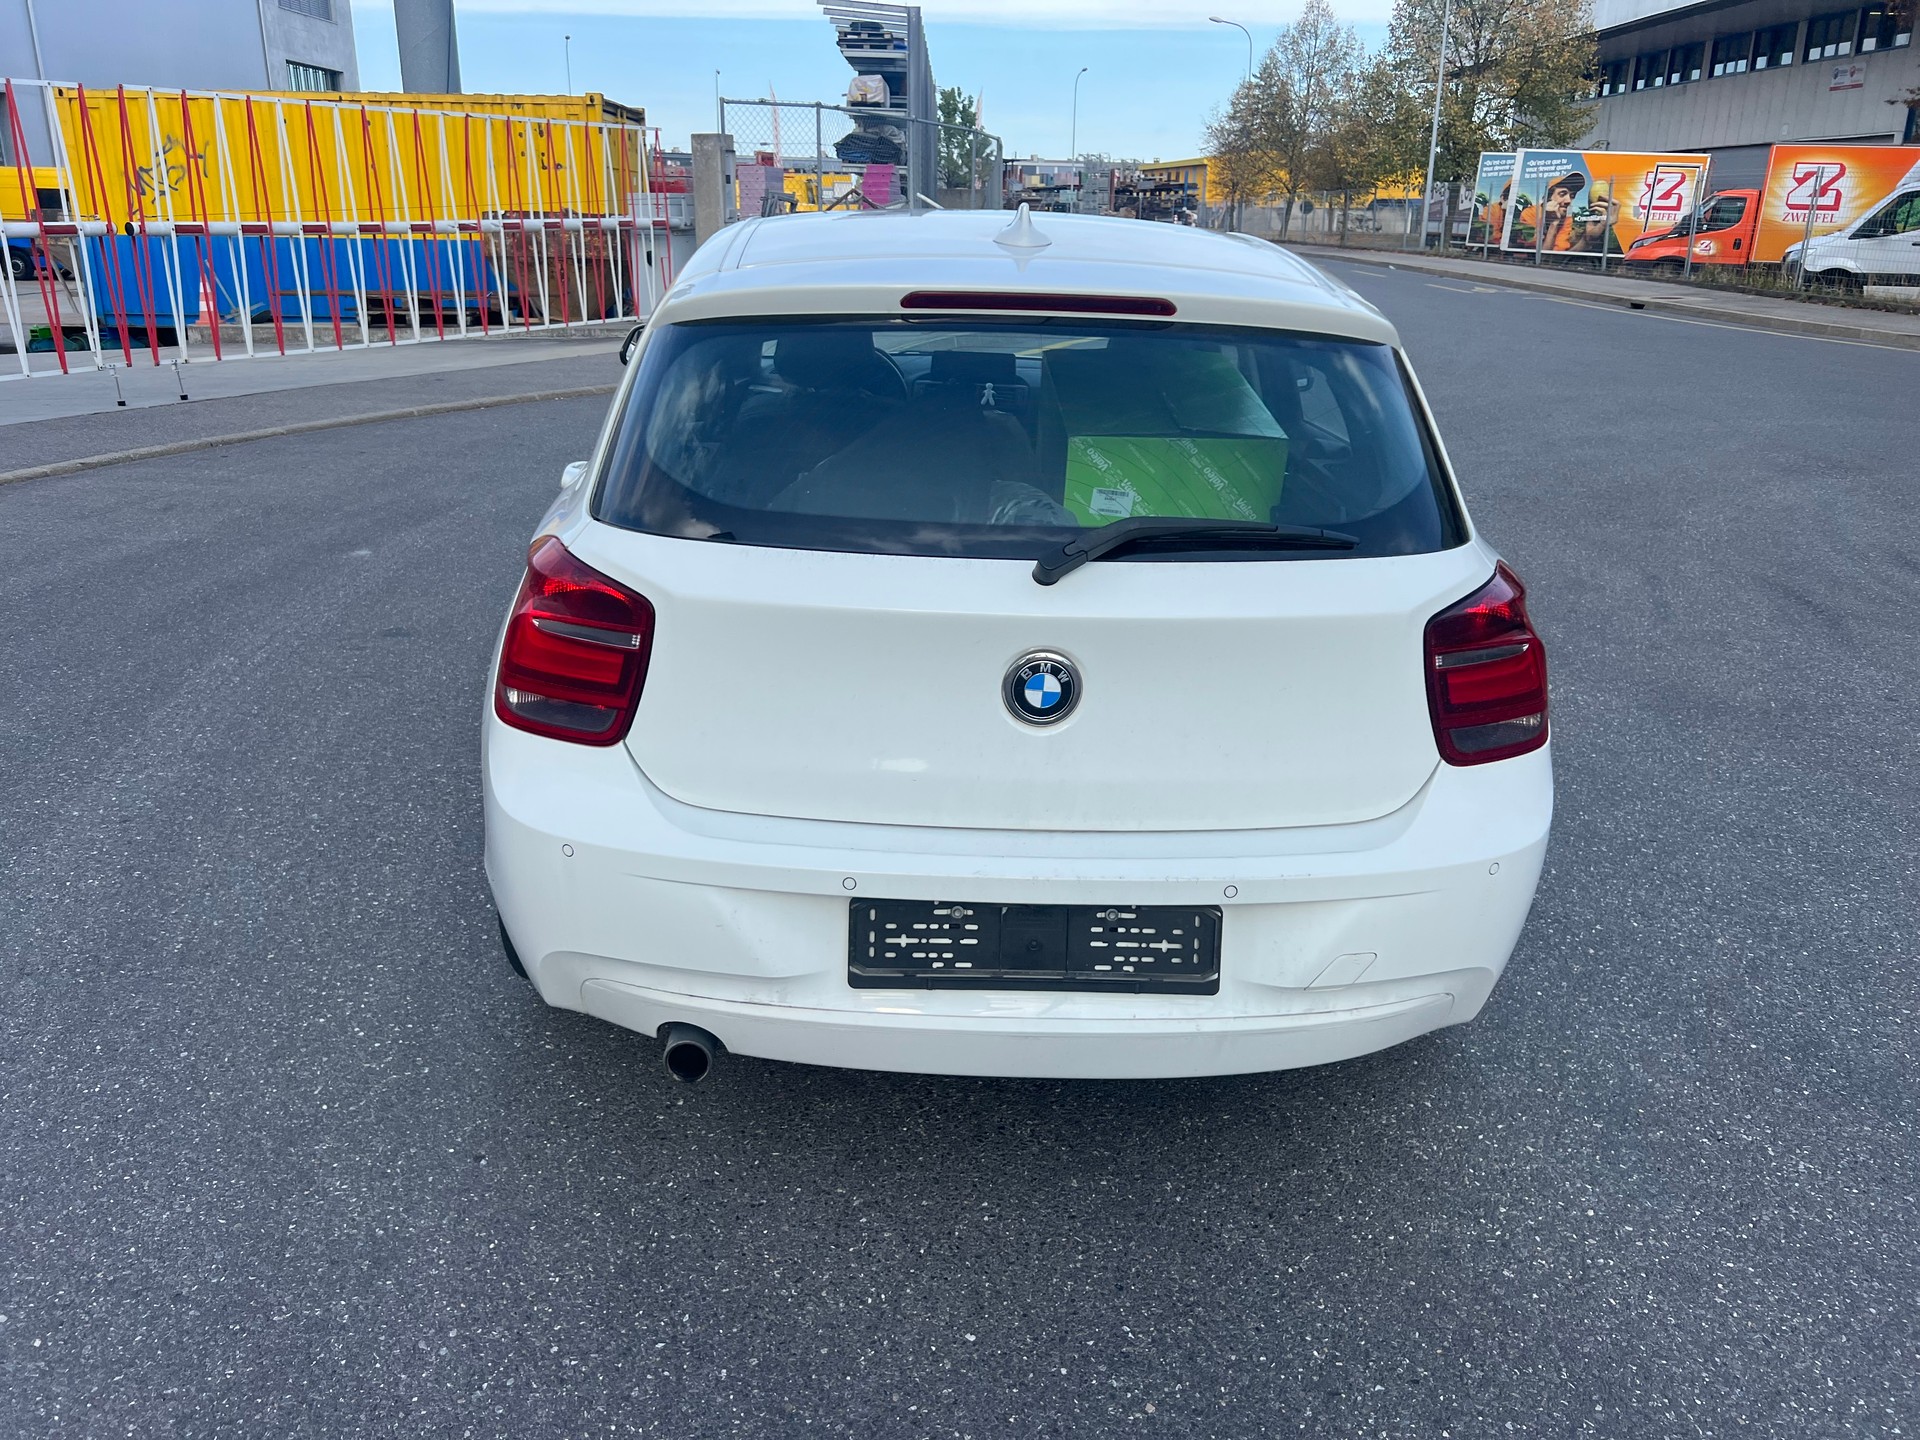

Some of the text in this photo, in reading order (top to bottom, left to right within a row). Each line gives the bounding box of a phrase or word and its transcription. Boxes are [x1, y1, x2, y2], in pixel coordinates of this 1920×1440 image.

[1639, 171, 1686, 211] Z
[1786, 162, 1846, 211] Z
[1783, 212, 1836, 223] ZWEFEL
[1087, 447, 1110, 472] Valeo
[1119, 478, 1142, 502] Valo
[1203, 466, 1225, 491] Valeo
[1236, 497, 1257, 520] Valeo
[1021, 663, 1070, 683] BMW
